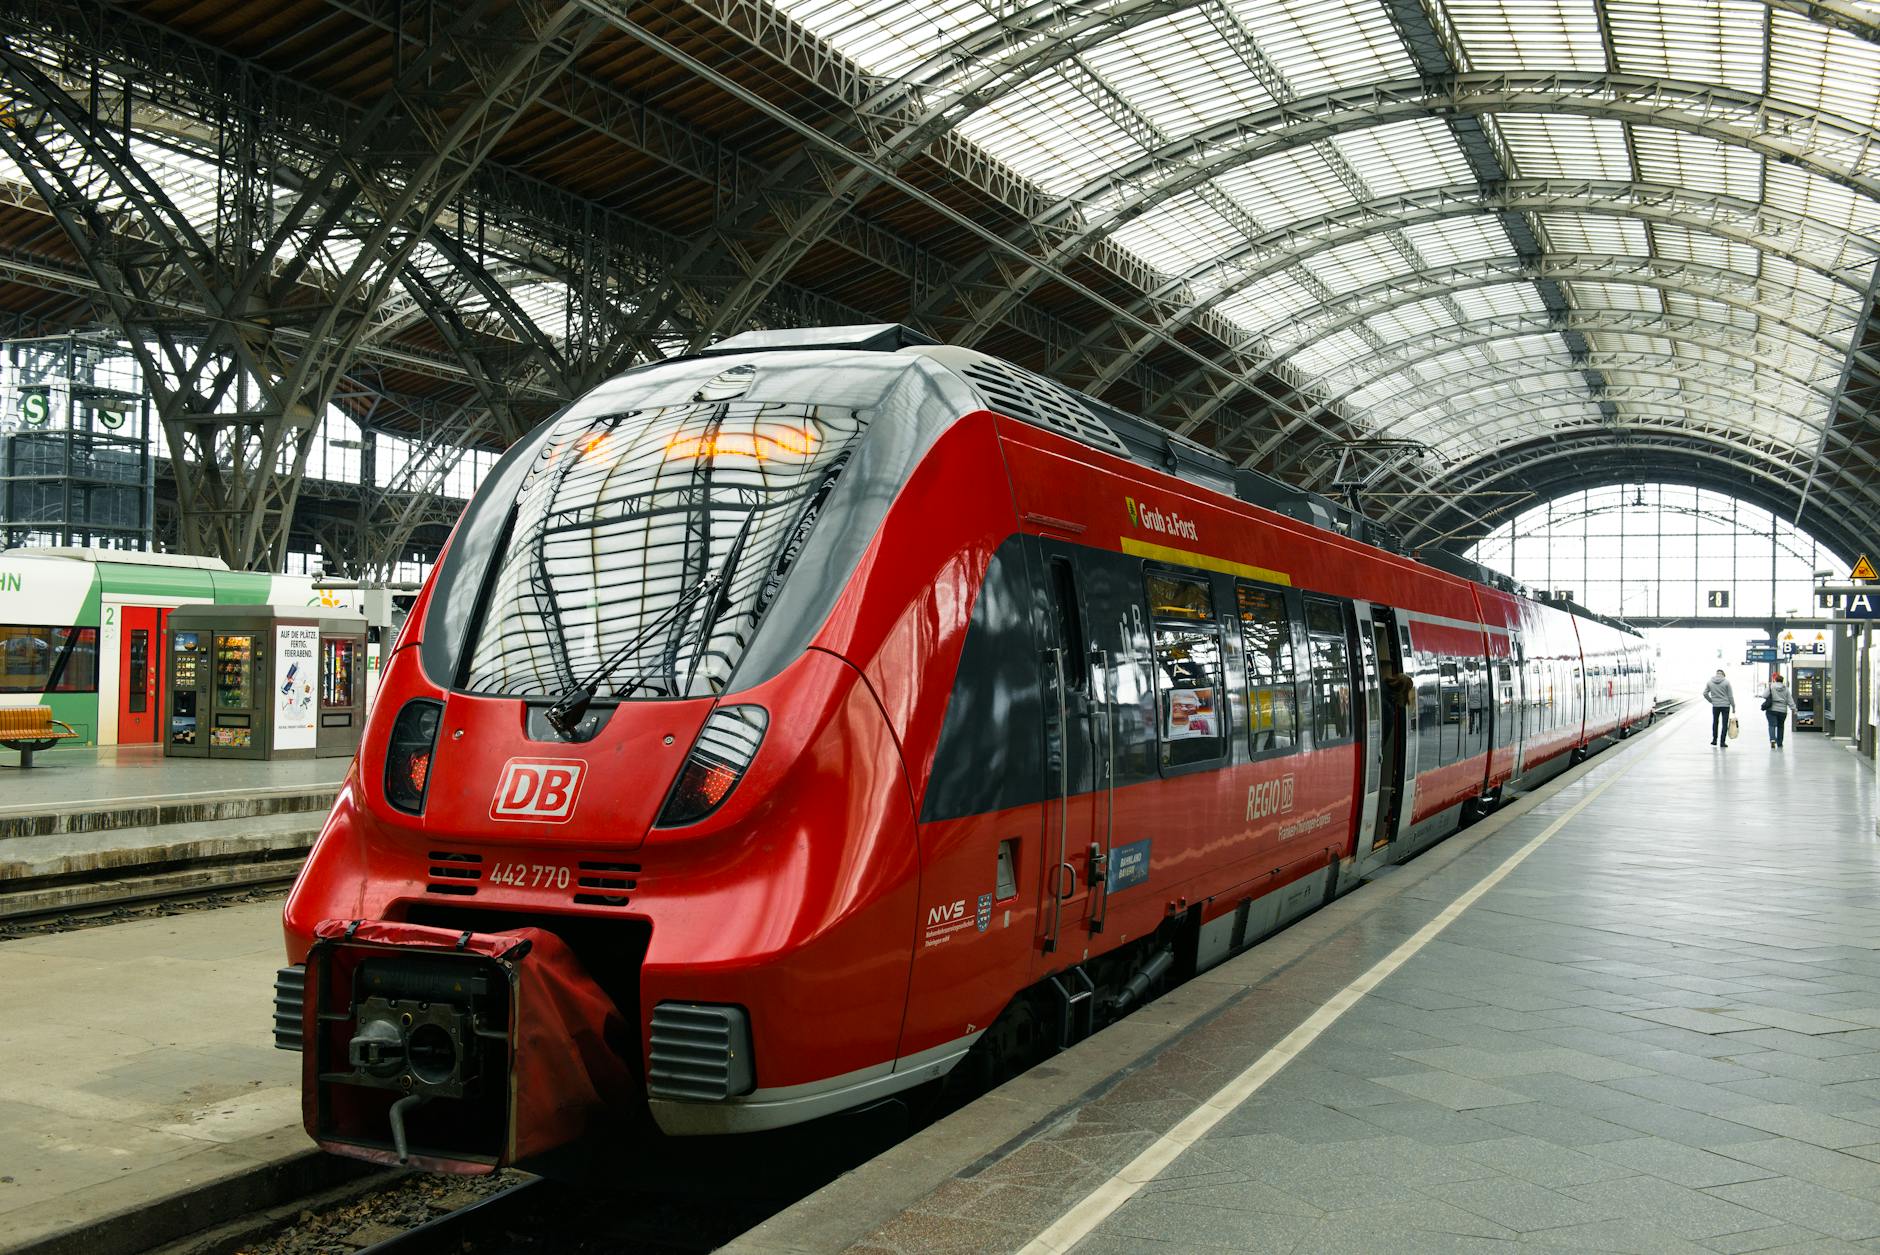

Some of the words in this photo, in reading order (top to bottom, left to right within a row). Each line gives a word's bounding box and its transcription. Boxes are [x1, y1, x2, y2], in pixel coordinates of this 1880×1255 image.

[25, 394, 44, 423] S
[1140, 503, 1166, 533] Grub
[1715, 591, 1722, 607] 8
[1850, 594, 1873, 612] A
[105, 607, 114, 625] 2
[280, 630, 290, 639] AUF
[291, 630, 299, 639] DIE
[290, 640, 307, 648] FERTIG.
[1784, 643, 1792, 652] B
[1817, 643, 1825, 653] B
[1105, 761, 1110, 779] 2
[503, 768, 571, 811] DB
[1246, 779, 1280, 821] REGIO
[490, 863, 527, 886] 442
[531, 865, 571, 889] 770
[927, 899, 965, 925] NVS
